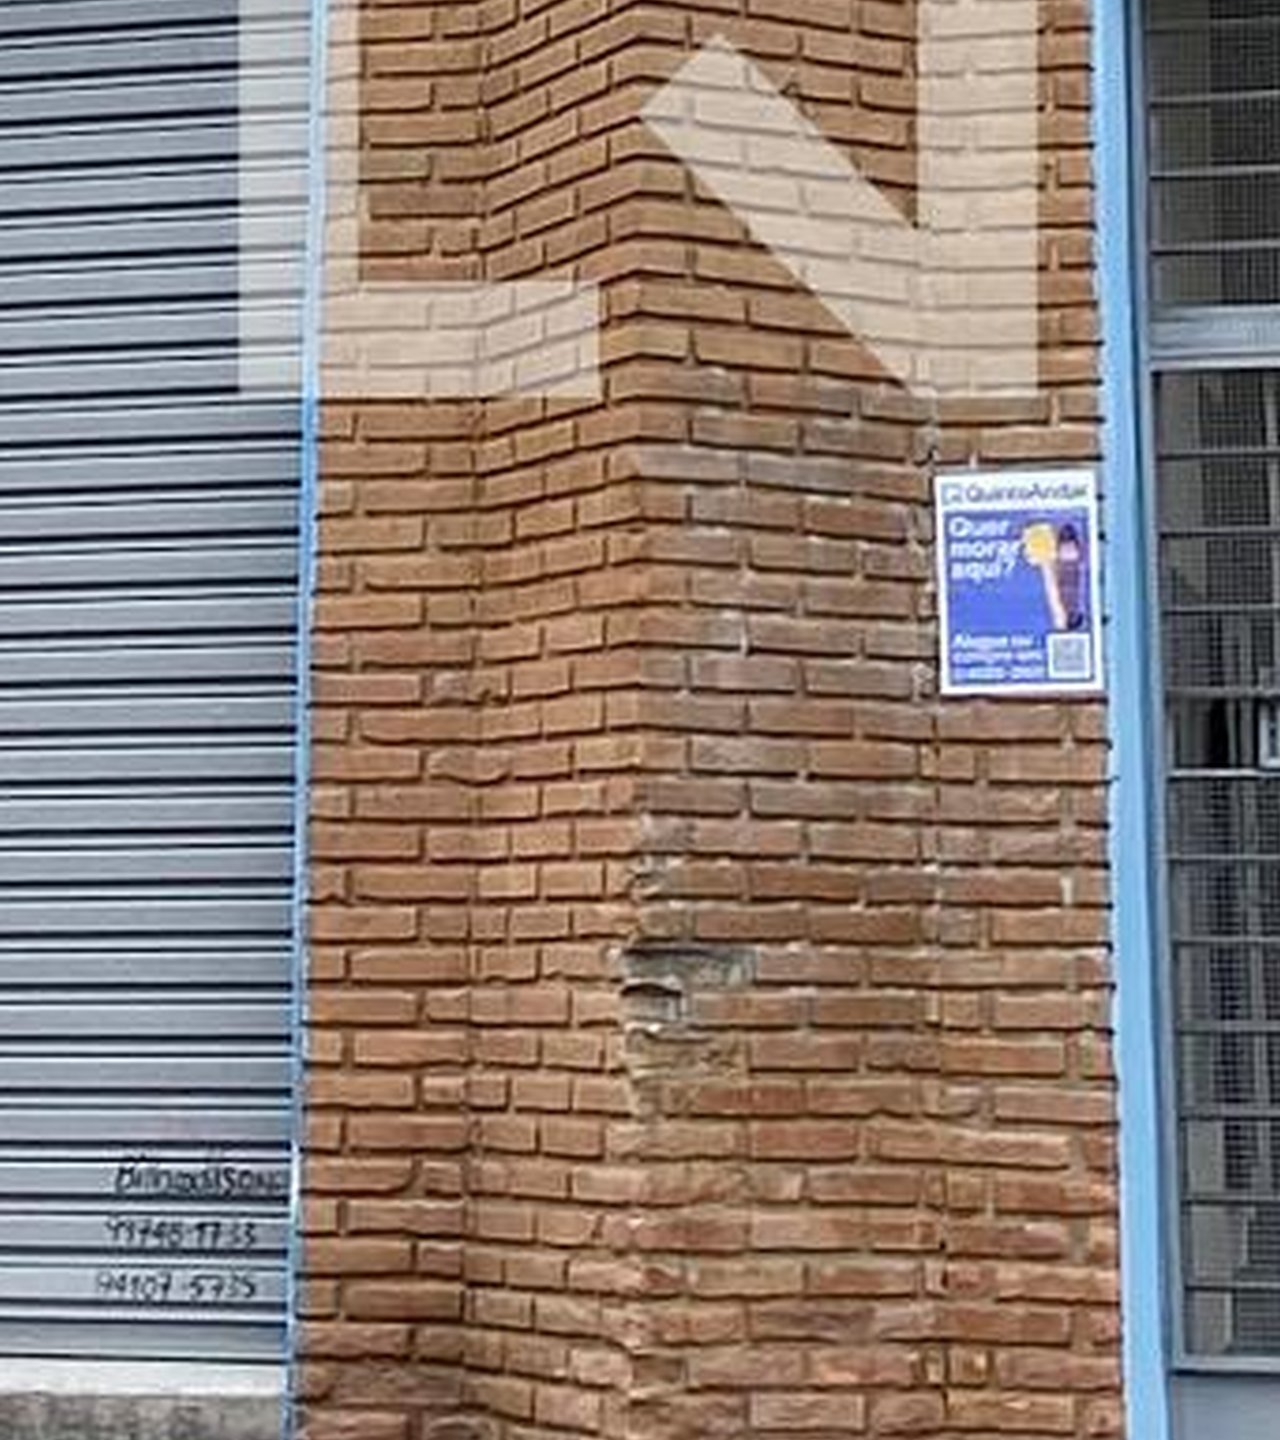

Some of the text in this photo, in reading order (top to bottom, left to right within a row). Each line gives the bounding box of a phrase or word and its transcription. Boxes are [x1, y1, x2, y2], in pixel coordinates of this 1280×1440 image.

[966, 481, 1089, 502] QuintoAndar
[949, 517, 1011, 537] Quer
[950, 541, 1020, 559] morar
[951, 559, 1016, 583] aqui?
